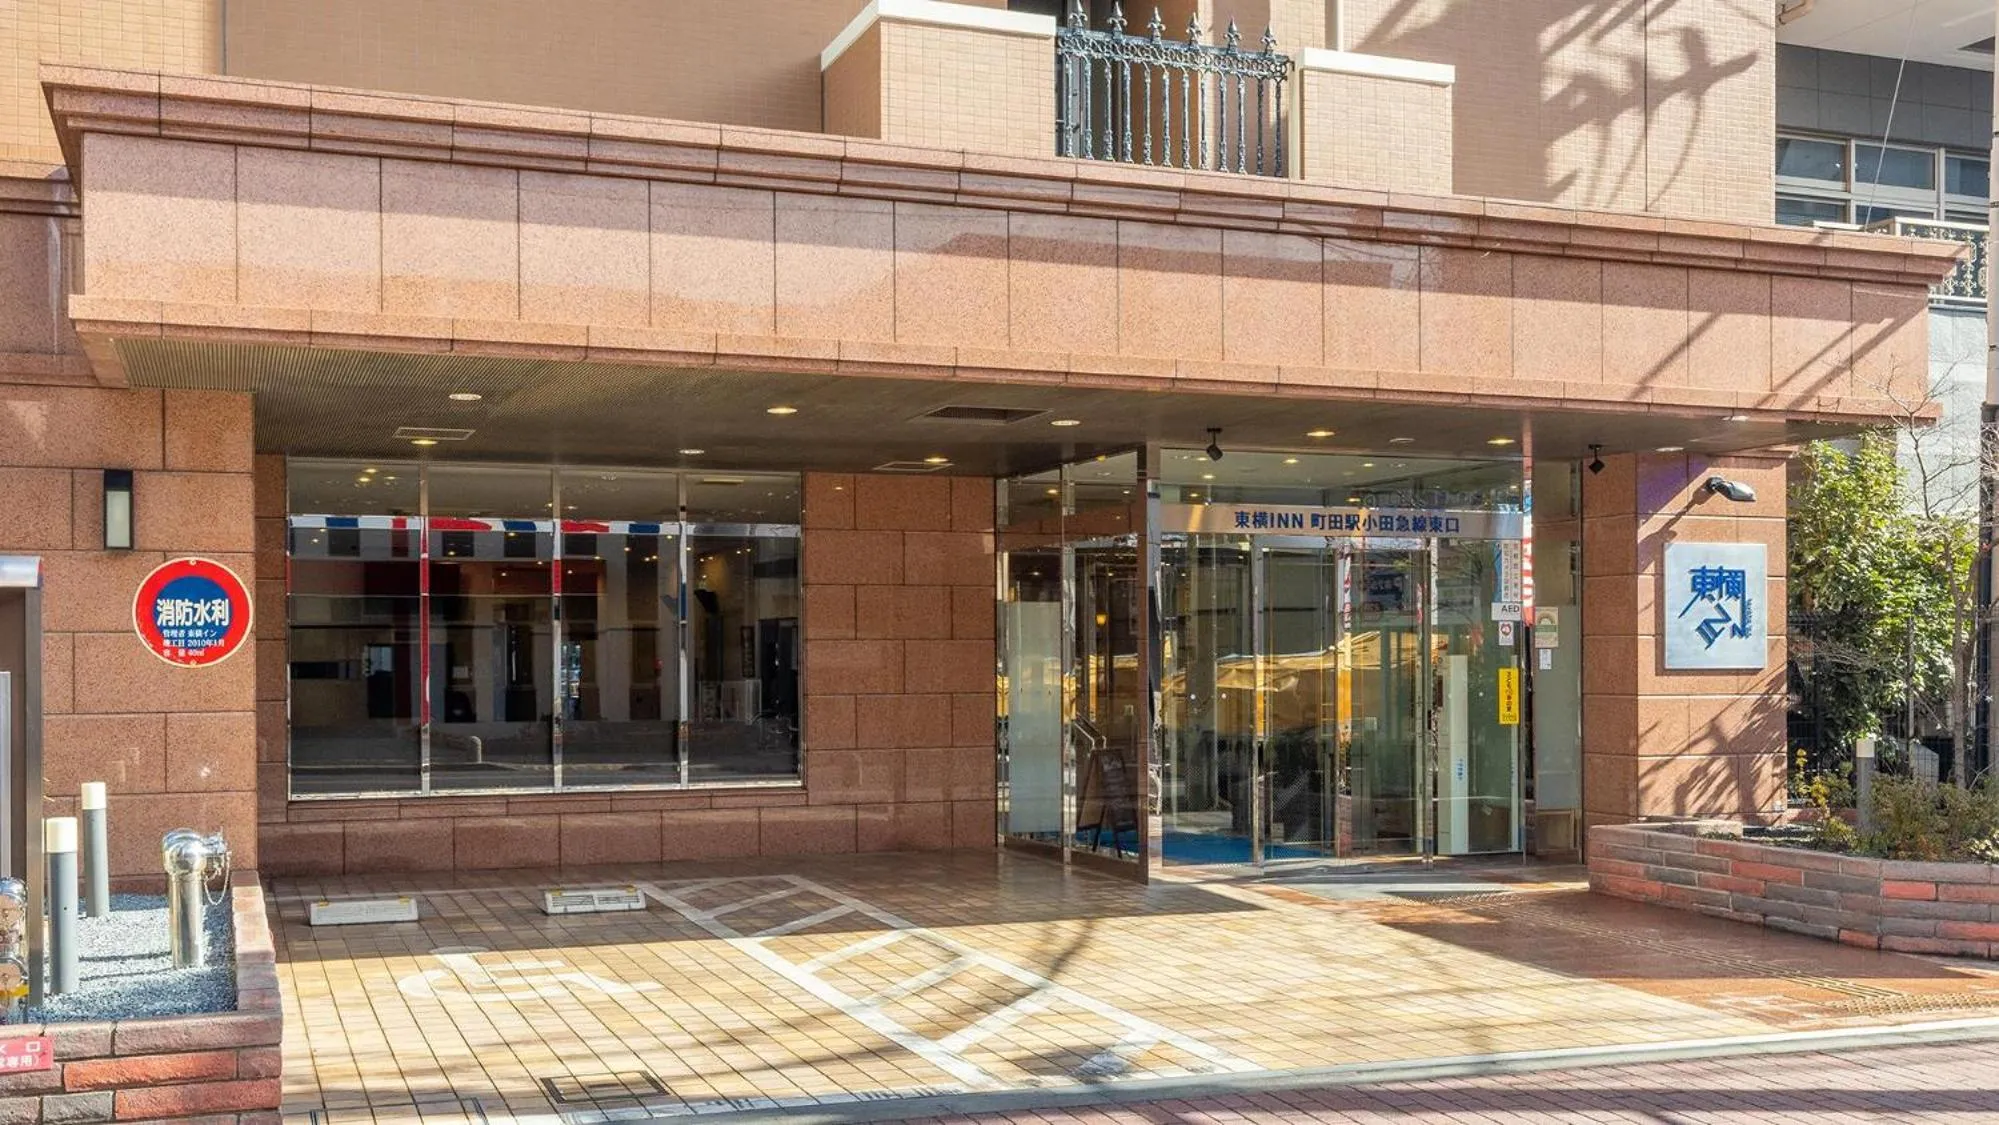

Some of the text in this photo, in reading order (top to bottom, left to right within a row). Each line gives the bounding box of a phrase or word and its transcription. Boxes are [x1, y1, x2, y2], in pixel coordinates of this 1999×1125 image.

[1235, 511, 1460, 533] 東横INN 町田駅小田急線東口
[156, 598, 230, 627] 消防水利
[1502, 604, 1520, 613] AED
